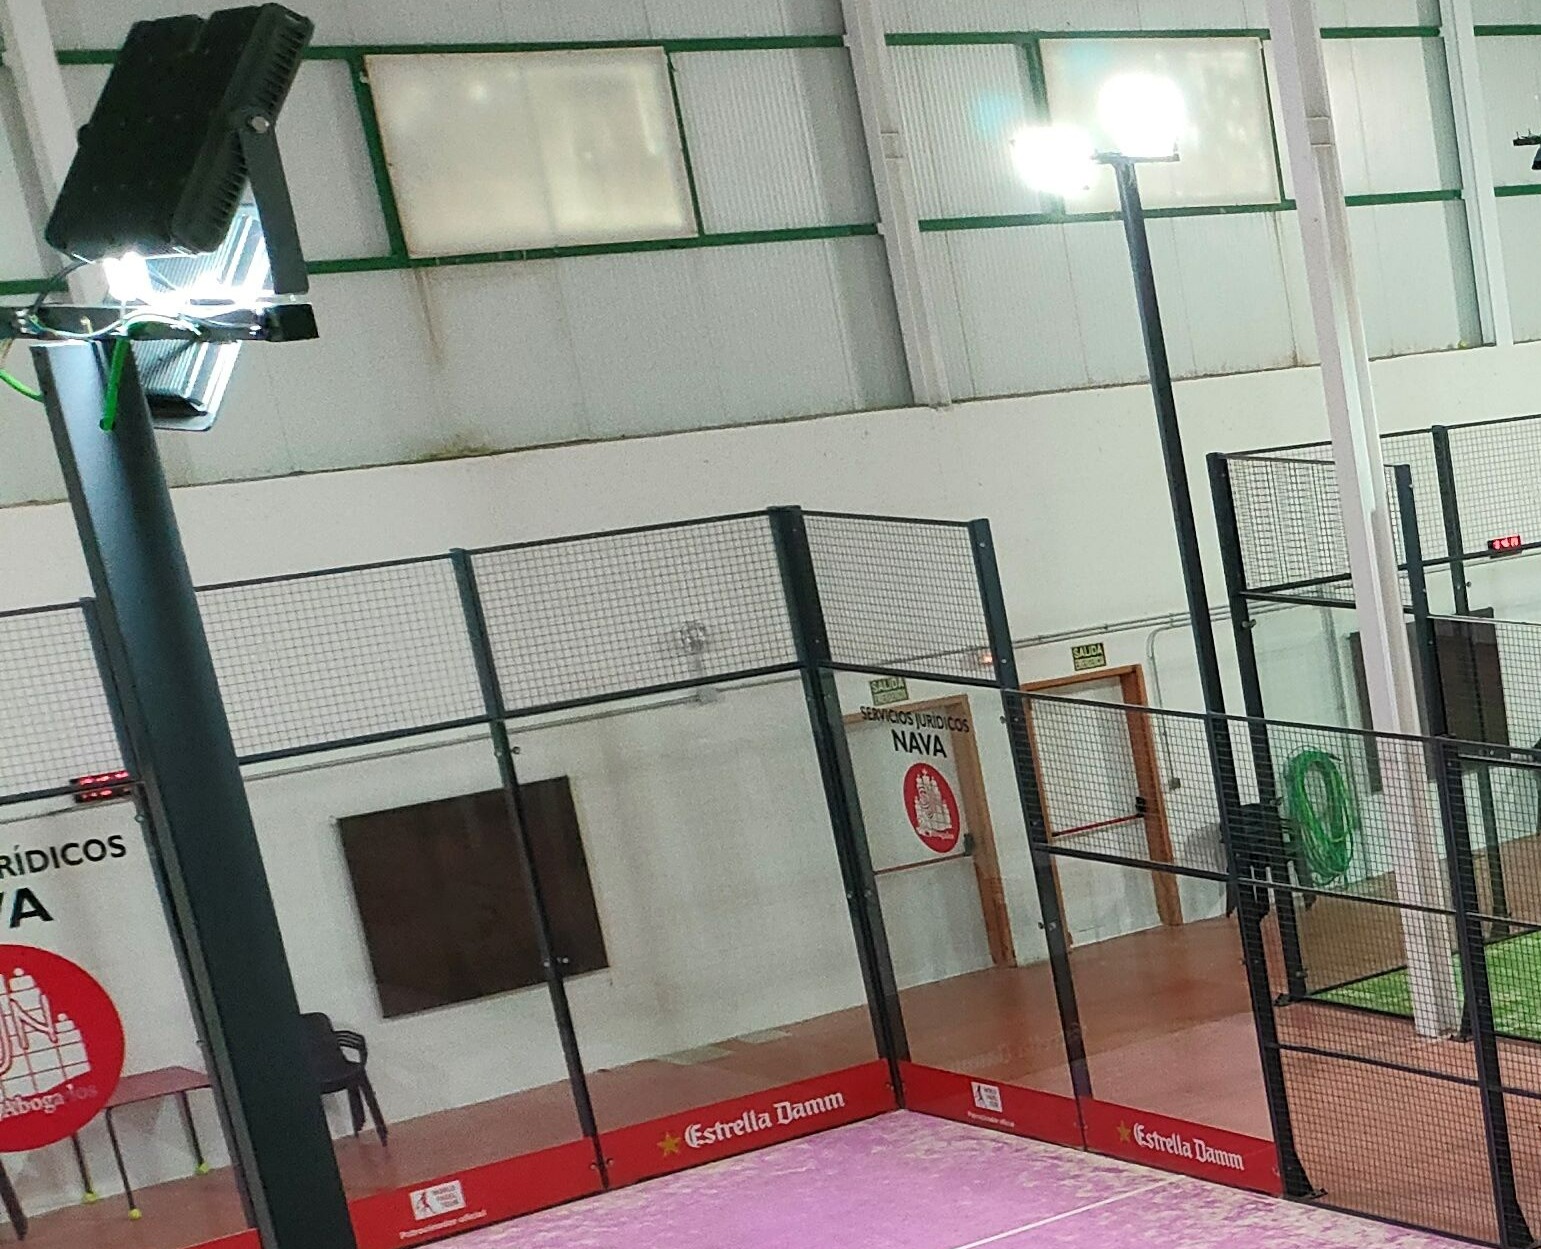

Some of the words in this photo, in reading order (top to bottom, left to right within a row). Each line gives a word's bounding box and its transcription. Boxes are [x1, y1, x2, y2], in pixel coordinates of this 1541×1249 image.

[1073, 644, 1103, 659] SALIDA
[860, 706, 914, 727] SERVICIOS
[892, 729, 948, 758] NAVA
[684, 1109, 773, 1148] Estrella
[773, 1092, 846, 1125] Damm
[1133, 1122, 1192, 1159] Estrella
[1193, 1138, 1245, 1170] Damm
